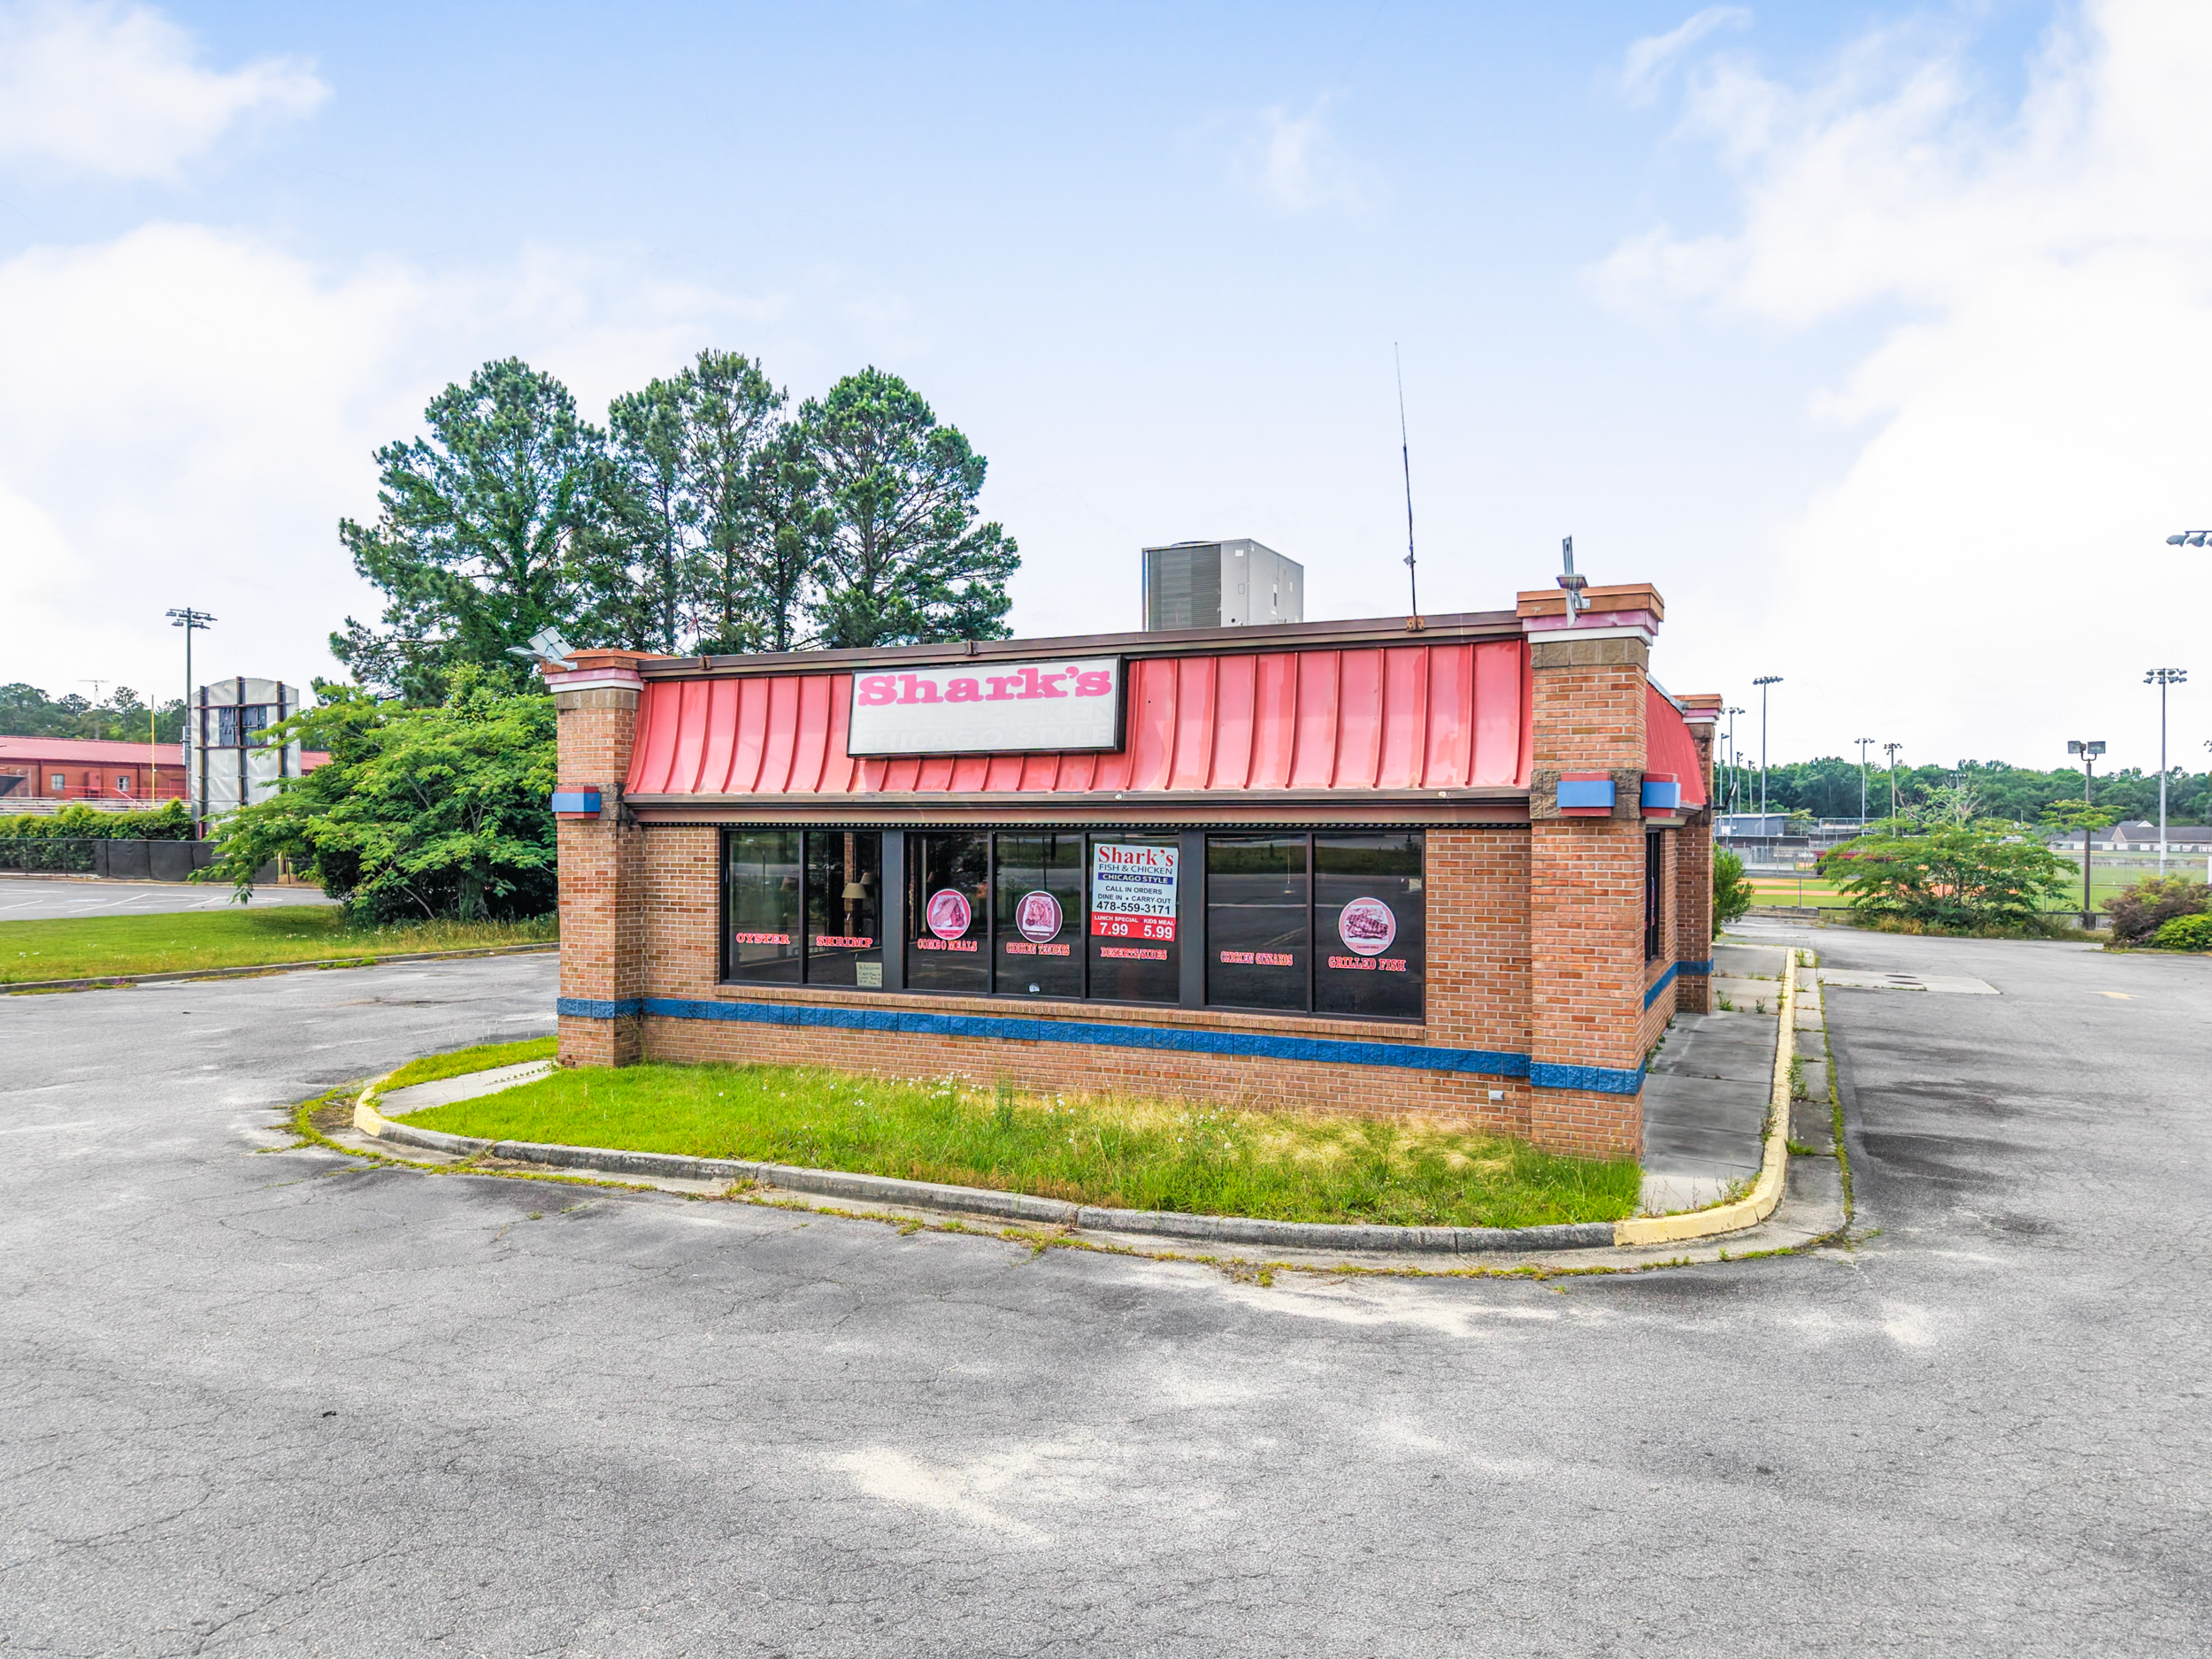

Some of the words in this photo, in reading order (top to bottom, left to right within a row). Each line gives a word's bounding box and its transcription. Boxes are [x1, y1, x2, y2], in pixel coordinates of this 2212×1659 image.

[857, 666, 1112, 707] Shark's
[856, 729, 1004, 749] CHICAGO
[1016, 726, 1109, 745] STYLE
[1099, 846, 1173, 866] Shark's
[1131, 865, 1172, 874] CHICKEN
[1097, 901, 1170, 914] 478-559-3171
[1100, 922, 1128, 935] 7.99
[1144, 925, 1172, 939] 5.99
[736, 933, 790, 945] OYSTER
[817, 936, 872, 948] SHRIMP
[917, 938, 947, 950] COMBO
[948, 941, 978, 952] MEALS
[1006, 942, 1037, 954] CHICKEN
[1038, 943, 1070, 956] TENDERS
[1101, 947, 1167, 960] DESERTS/SIDES
[1220, 951, 1254, 964] CHICKEN
[1256, 952, 1293, 966] GIZZARDS
[1328, 956, 1376, 970] GRILLED
[1379, 958, 1406, 972] FISH
